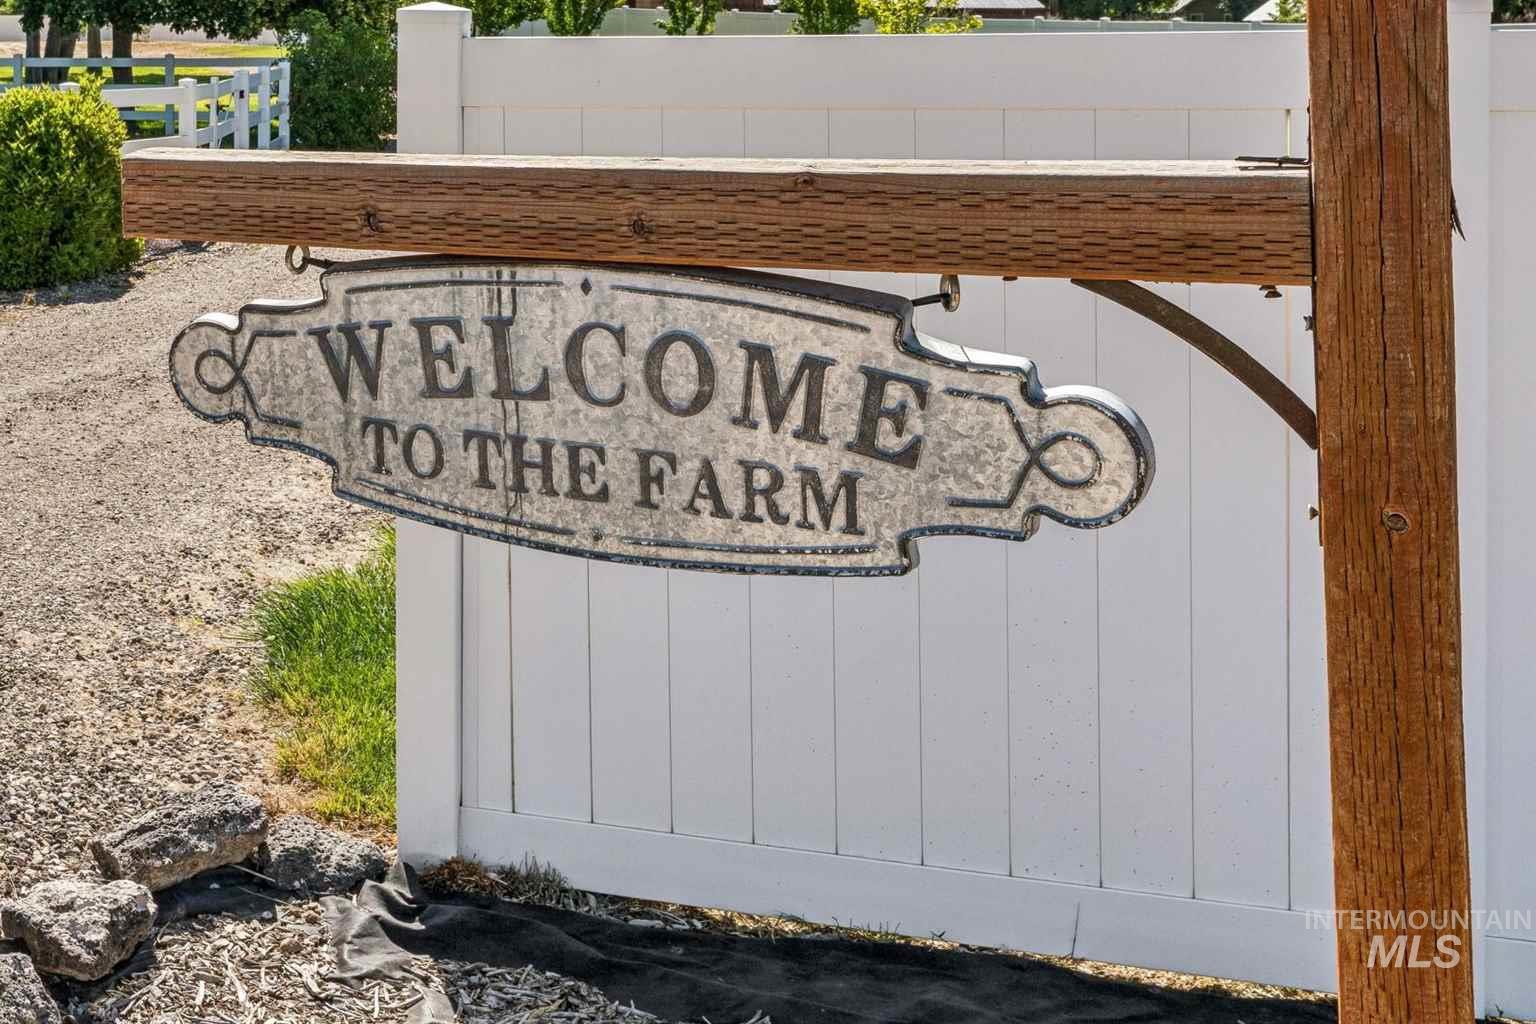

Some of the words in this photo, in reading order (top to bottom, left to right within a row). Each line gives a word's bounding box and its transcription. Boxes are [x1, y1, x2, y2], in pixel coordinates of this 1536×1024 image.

[308, 314, 932, 471] WELCOME
[360, 417, 446, 480] TO
[462, 427, 610, 503] THE
[633, 446, 866, 537] FARM
